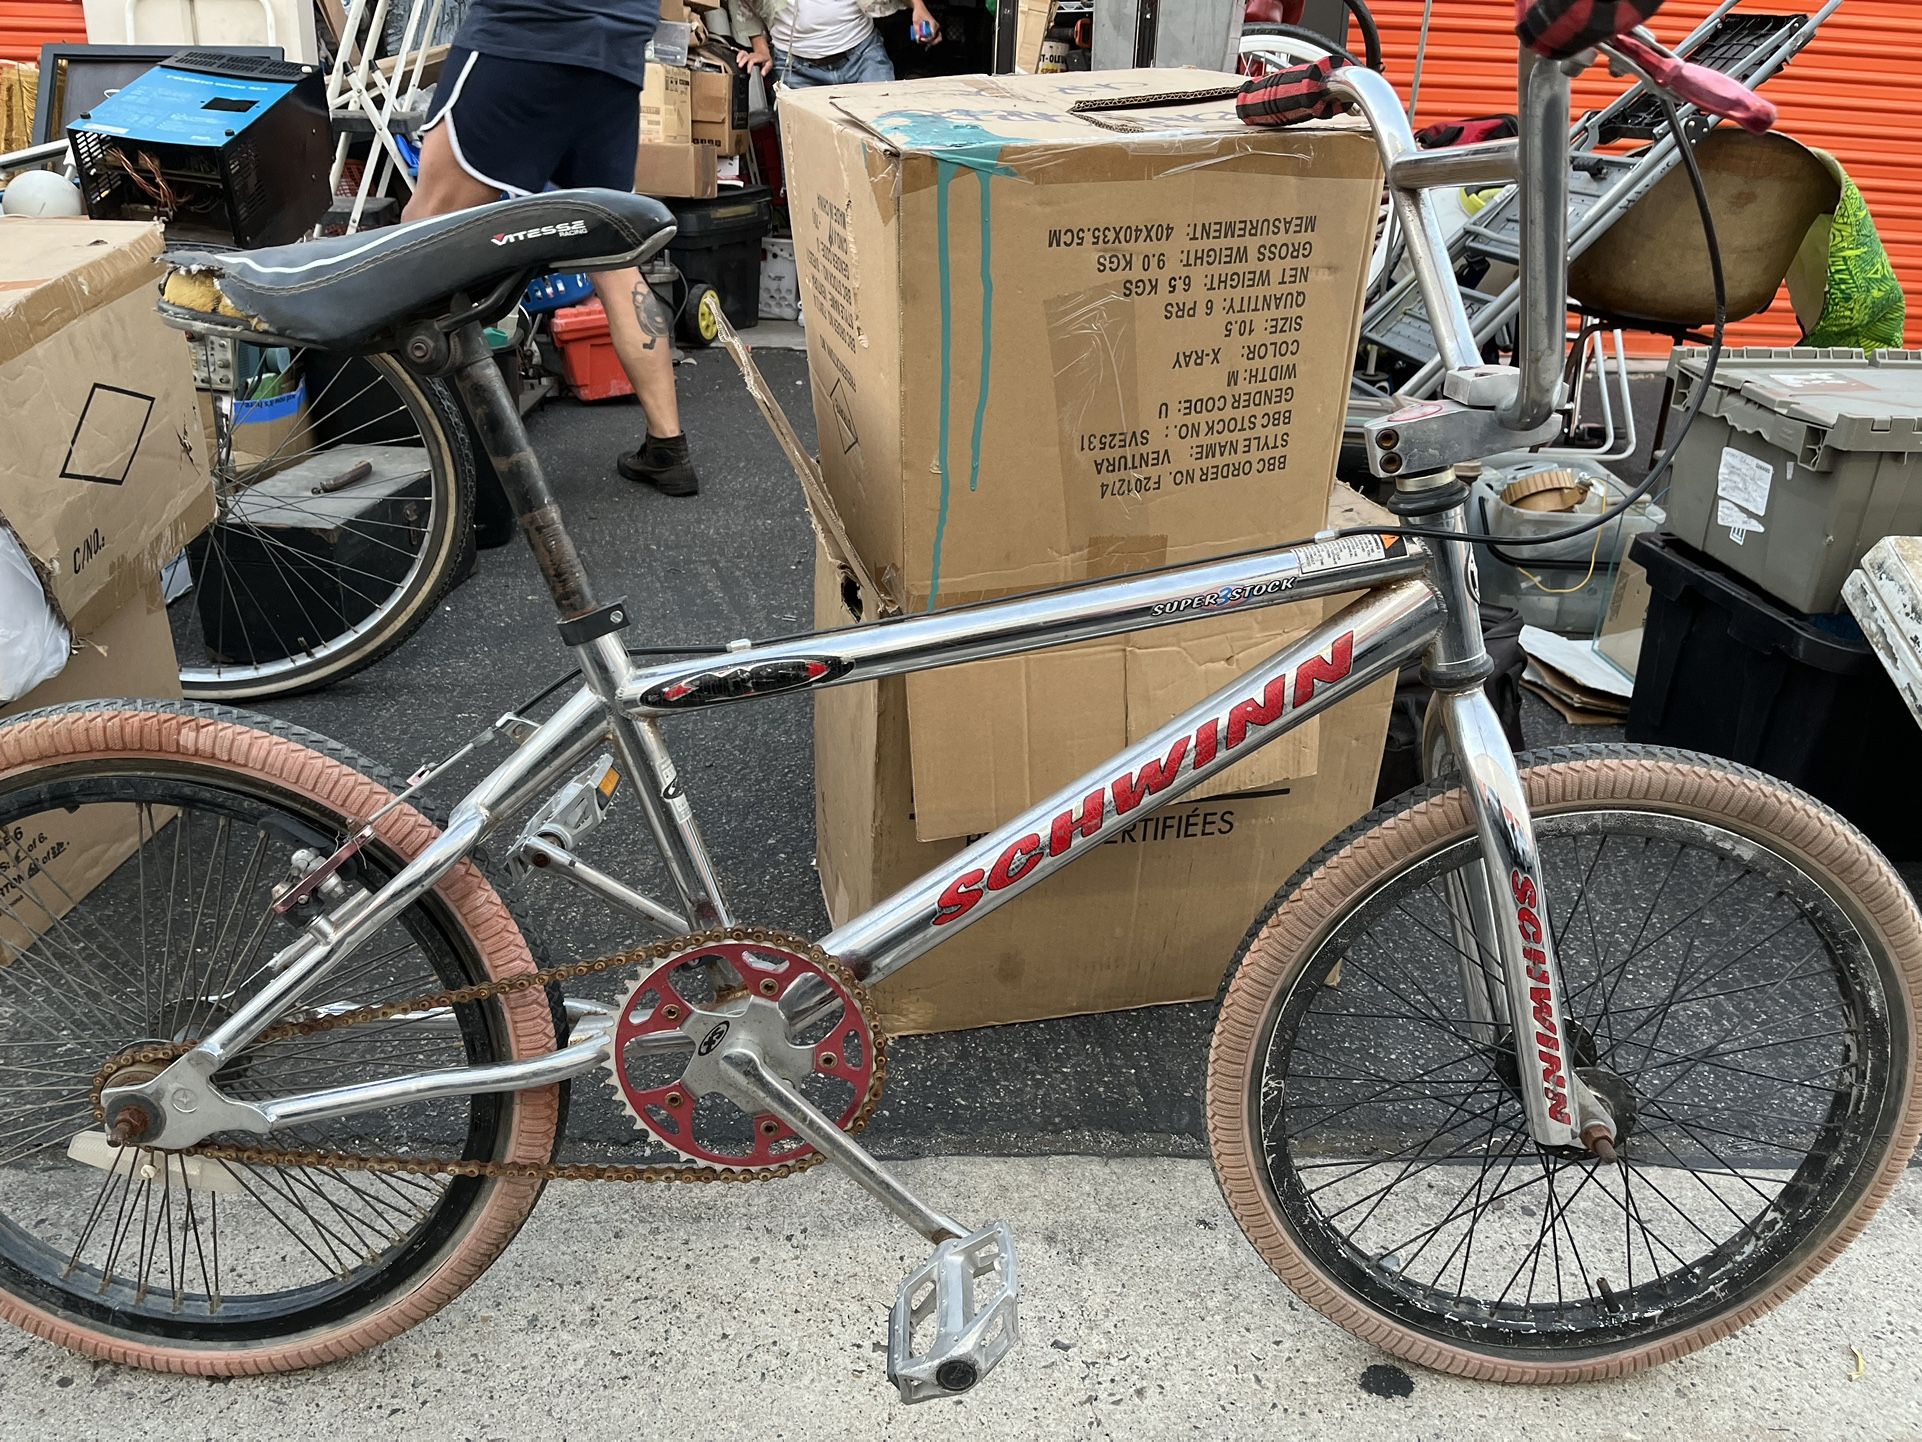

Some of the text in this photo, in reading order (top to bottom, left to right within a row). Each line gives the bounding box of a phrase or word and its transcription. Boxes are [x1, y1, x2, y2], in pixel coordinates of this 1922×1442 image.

[490, 219, 587, 246] VITESSE
[558, 228, 588, 238] RACING
[1048, 216, 1317, 247] MEASUREMENT: 40X40X35.5CM
[1096, 241, 1313, 273] GROSS WEIGHT: 9.0 KGS
[1122, 266, 1310, 297] NET WEIGHT: 6.5 KGS
[1164, 290, 1306, 320] QUANTITY: 6 PRS
[1224, 316, 1303, 338] SIZE: 10.5
[1171, 339, 1300, 369] COLOR: X-RAY
[1227, 363, 1297, 387] WIDTH: M
[1159, 387, 1294, 418] GENDER CODE: U
[1204, 414, 1257, 436] STOCK
[1261, 409, 1292, 429] BBC
[1080, 430, 1150, 452] SVE2531
[1094, 432, 1289, 475] STYLE NAME: VENTURA
[1100, 455, 1287, 499] BBC ORDER NO. F201274
[1151, 593, 1219, 617] SUPER
[1230, 576, 1297, 601] STOCK
[932, 629, 1354, 926] SCHWINN
[13, 826, 24, 841] 6
[1511, 869, 1572, 1127] SCHWINN
